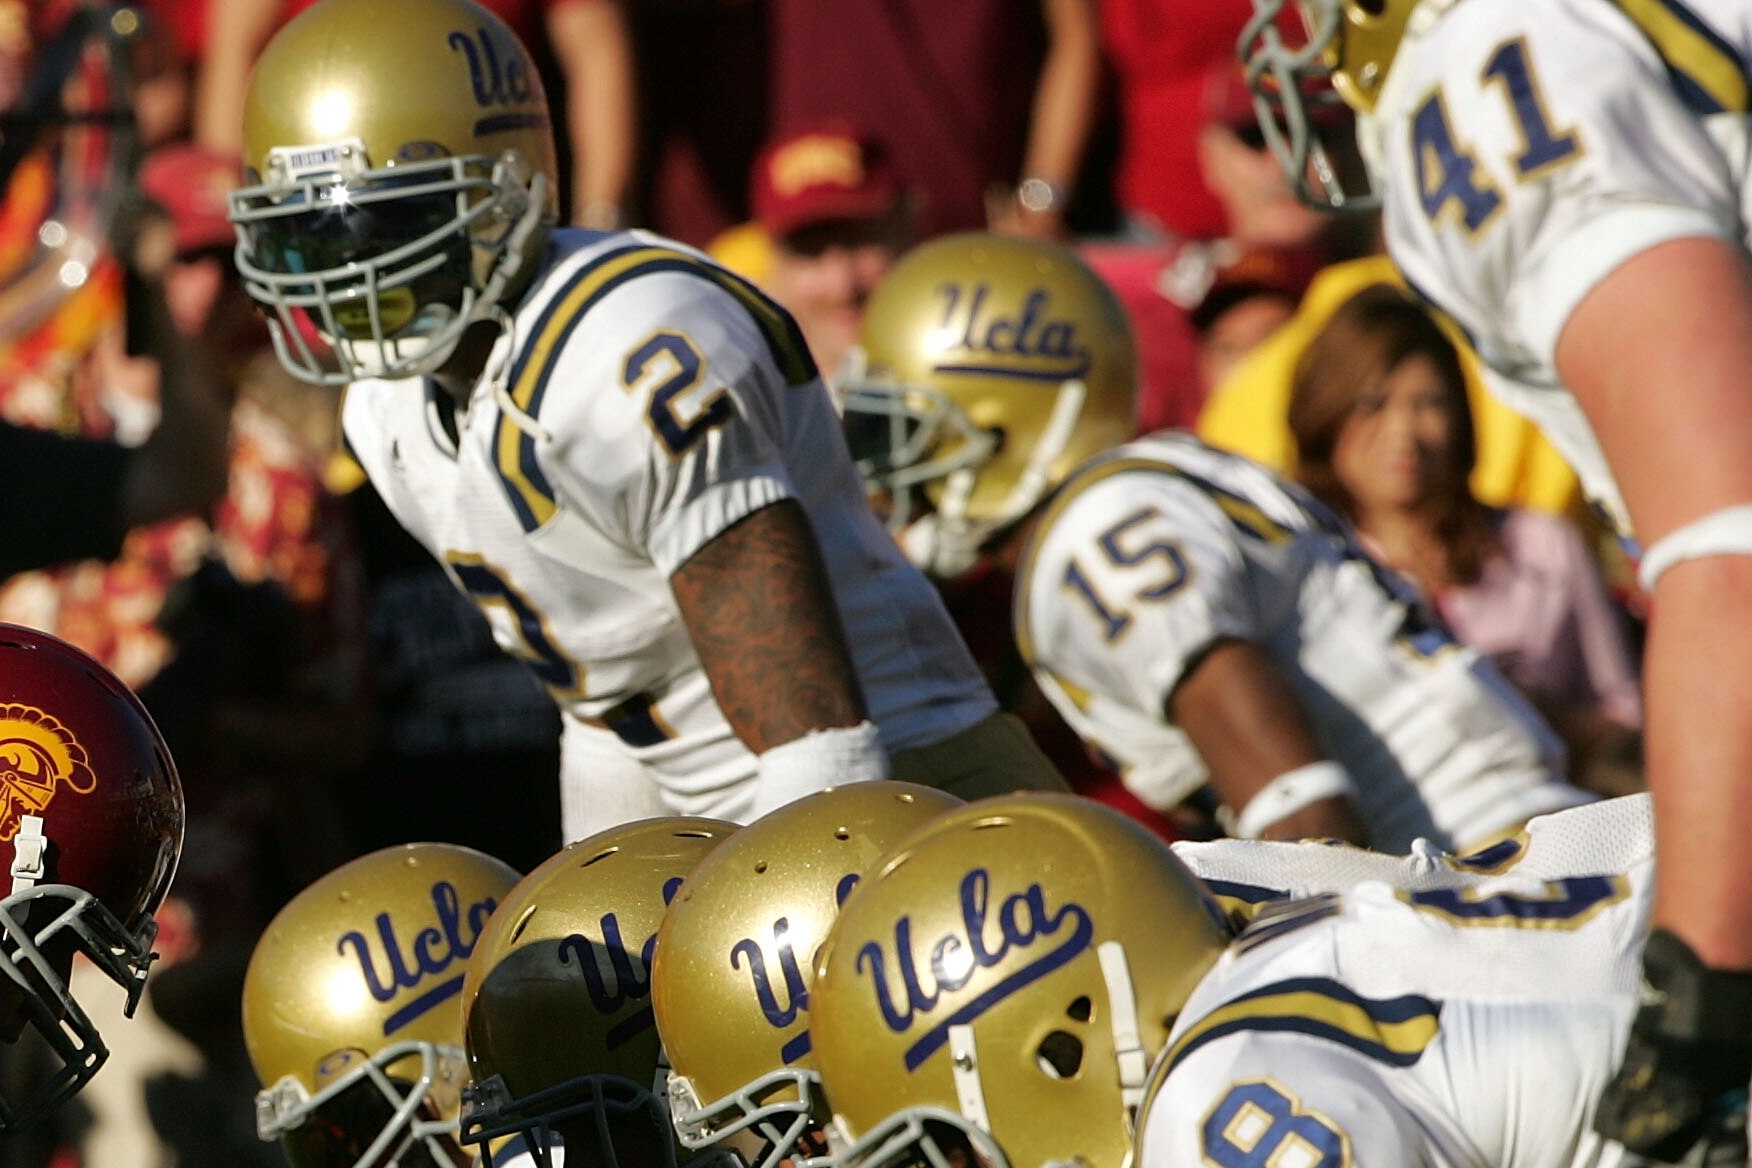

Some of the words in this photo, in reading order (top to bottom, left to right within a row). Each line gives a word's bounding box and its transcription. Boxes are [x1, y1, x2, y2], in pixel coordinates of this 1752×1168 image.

[1408, 32, 1588, 244] 41
[618, 325, 732, 462] 2
[936, 282, 1093, 382] Ucla
[1060, 505, 1195, 650] 15
[856, 867, 1093, 1073] Ucla
